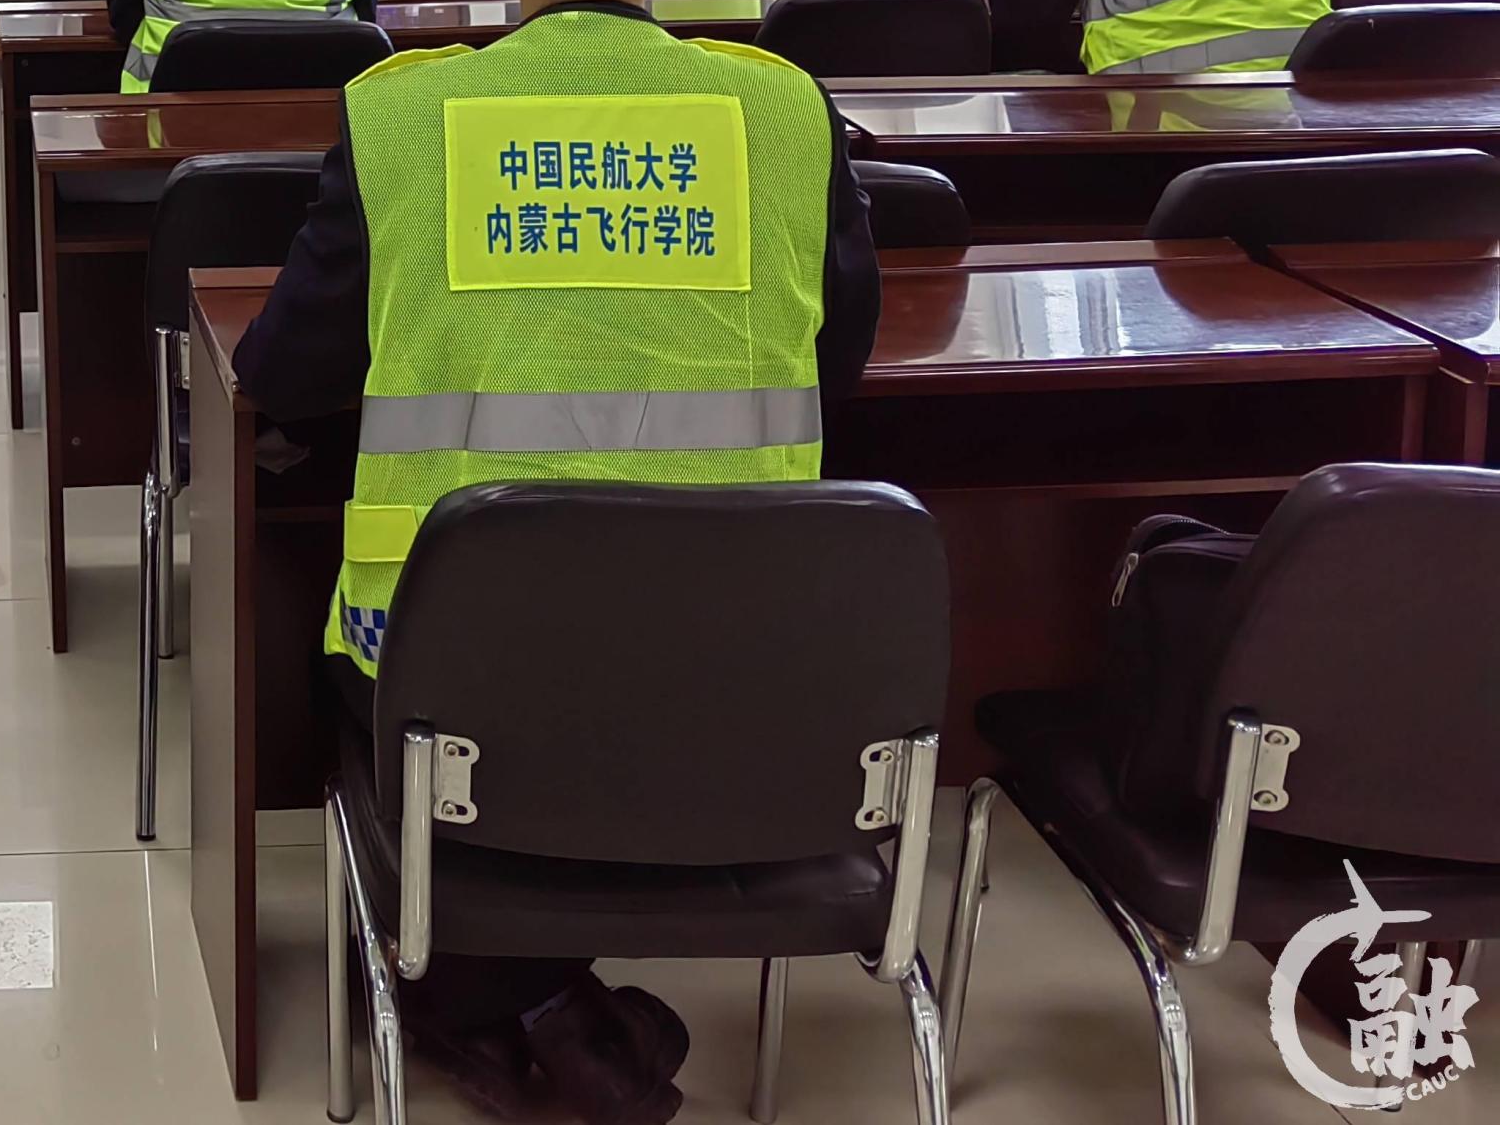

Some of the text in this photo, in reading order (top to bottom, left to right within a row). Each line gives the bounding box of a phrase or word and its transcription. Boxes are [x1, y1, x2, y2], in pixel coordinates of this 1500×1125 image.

[500, 140, 697, 193] 中国民航大学
[487, 202, 716, 256] 内蒙古飞行学院
